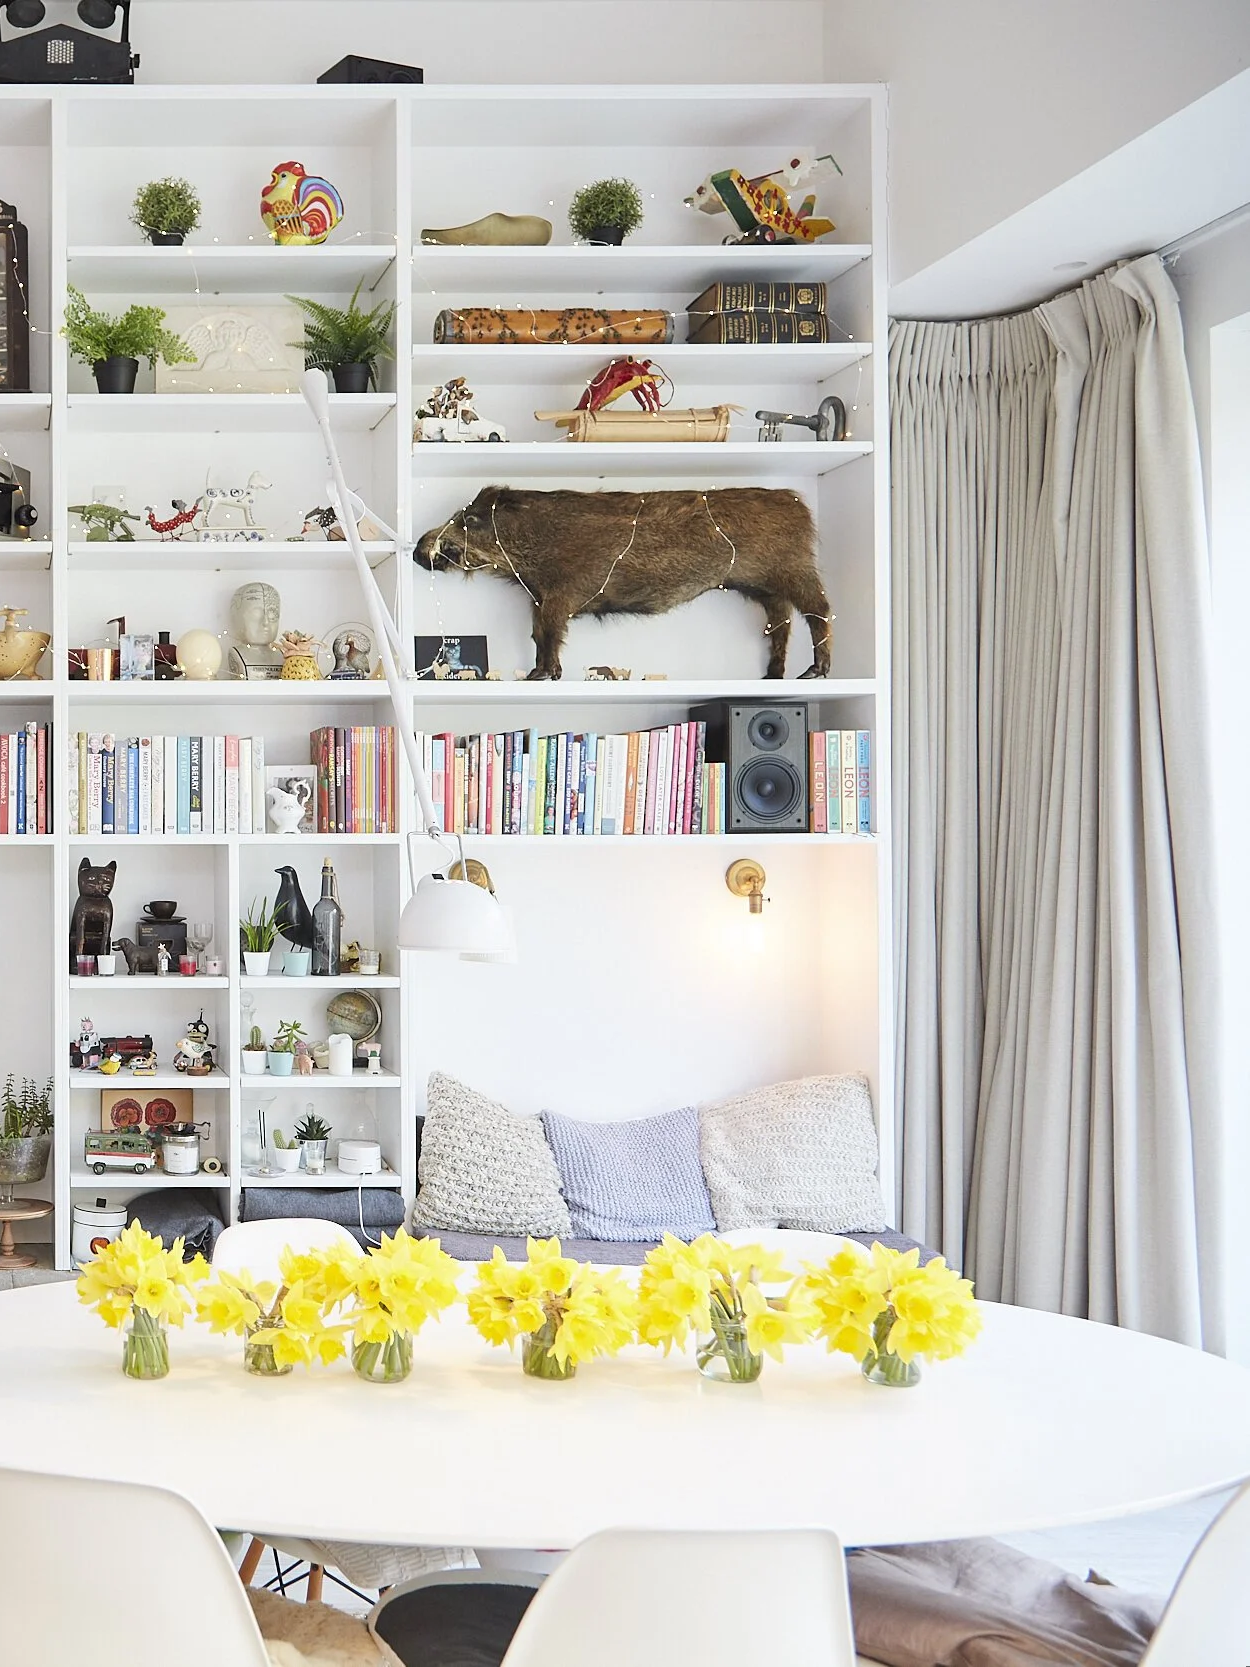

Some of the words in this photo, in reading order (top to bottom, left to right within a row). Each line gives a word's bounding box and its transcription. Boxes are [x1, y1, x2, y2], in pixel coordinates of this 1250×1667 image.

[92, 755, 100, 777] Mary
[106, 757, 114, 779] Mary
[92, 782, 100, 808] Berry
[106, 780, 114, 803] Berry
[814, 761, 824, 802] LEON
[829, 767, 838, 798] LEON
[844, 767, 854, 798] LEON
[859, 767, 869, 798] LEON
